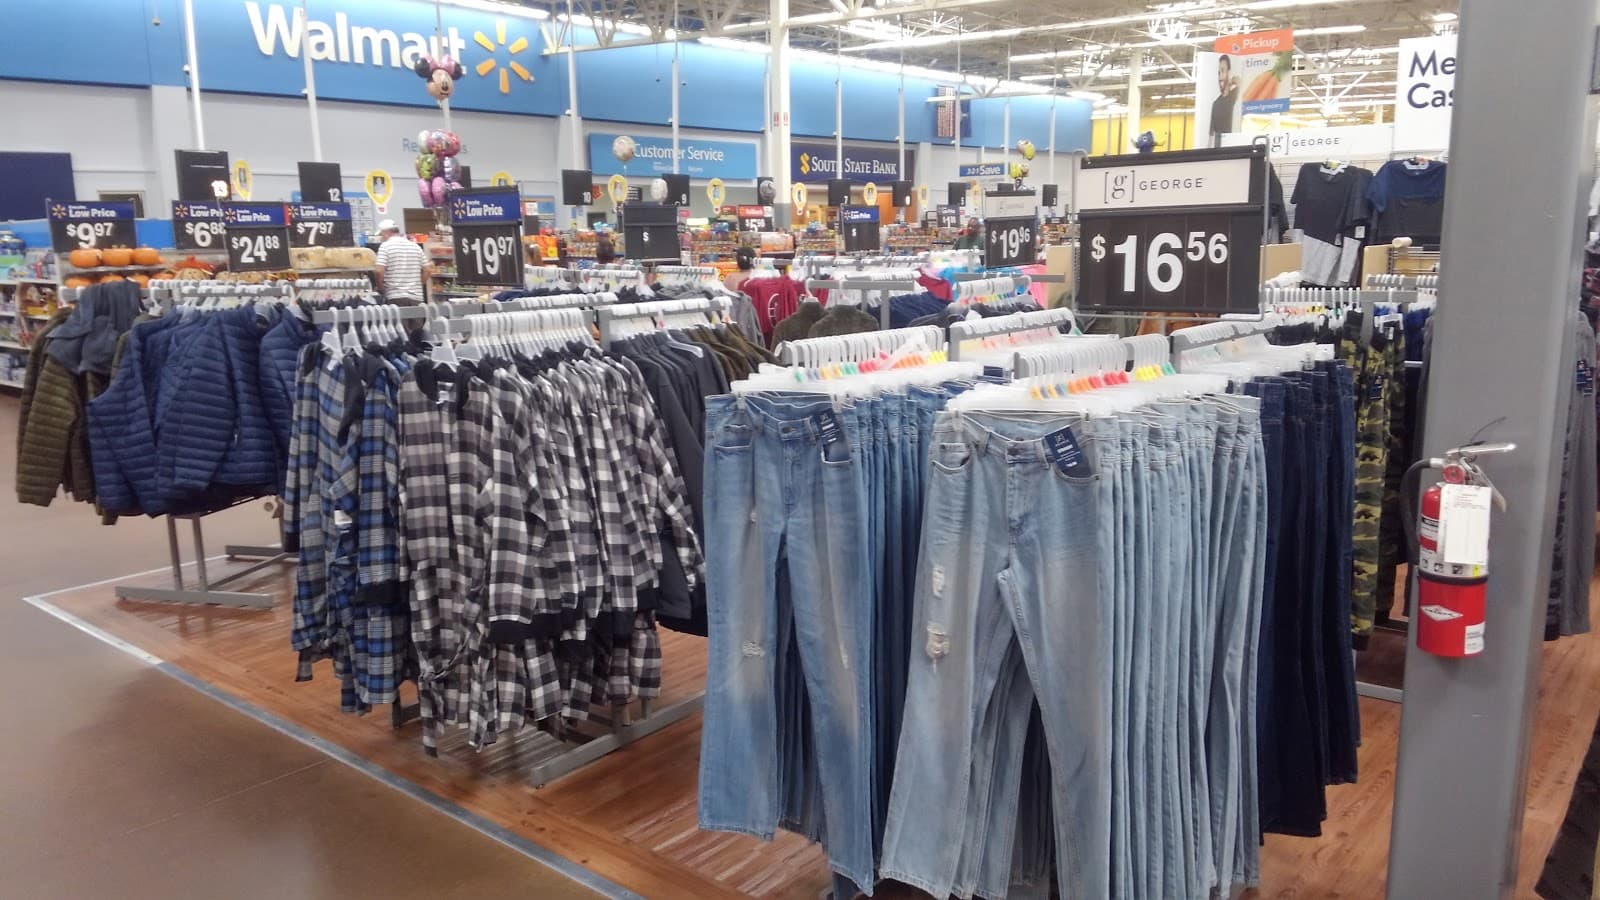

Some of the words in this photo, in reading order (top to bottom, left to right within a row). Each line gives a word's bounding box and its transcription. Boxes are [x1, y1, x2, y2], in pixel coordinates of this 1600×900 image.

[245, 1, 466, 74] Walmart
[1243, 37, 1279, 49] Pickup
[1246, 57, 1269, 68] time
[1408, 49, 1456, 77] Me
[1291, 137, 1340, 147] GEORGE
[687, 146, 725, 161] Service
[844, 158, 872, 174] STATE
[872, 159, 897, 175] BANK
[1138, 177, 1204, 191] GEORGE
[328, 187, 341, 202] 12
[583, 191, 592, 204] 10
[681, 193, 687, 204] 9
[69, 208, 90, 218] Low
[91, 207, 117, 218] Price
[190, 208, 210, 218] Low
[210, 208, 224, 218] Pri
[301, 208, 317, 217] Low
[318, 207, 338, 217] Price
[466, 205, 483, 217] Low
[483, 203, 503, 216] Price
[237, 212, 253, 222] Low
[253, 212, 271, 222] Price
[642, 231, 649, 242] $
